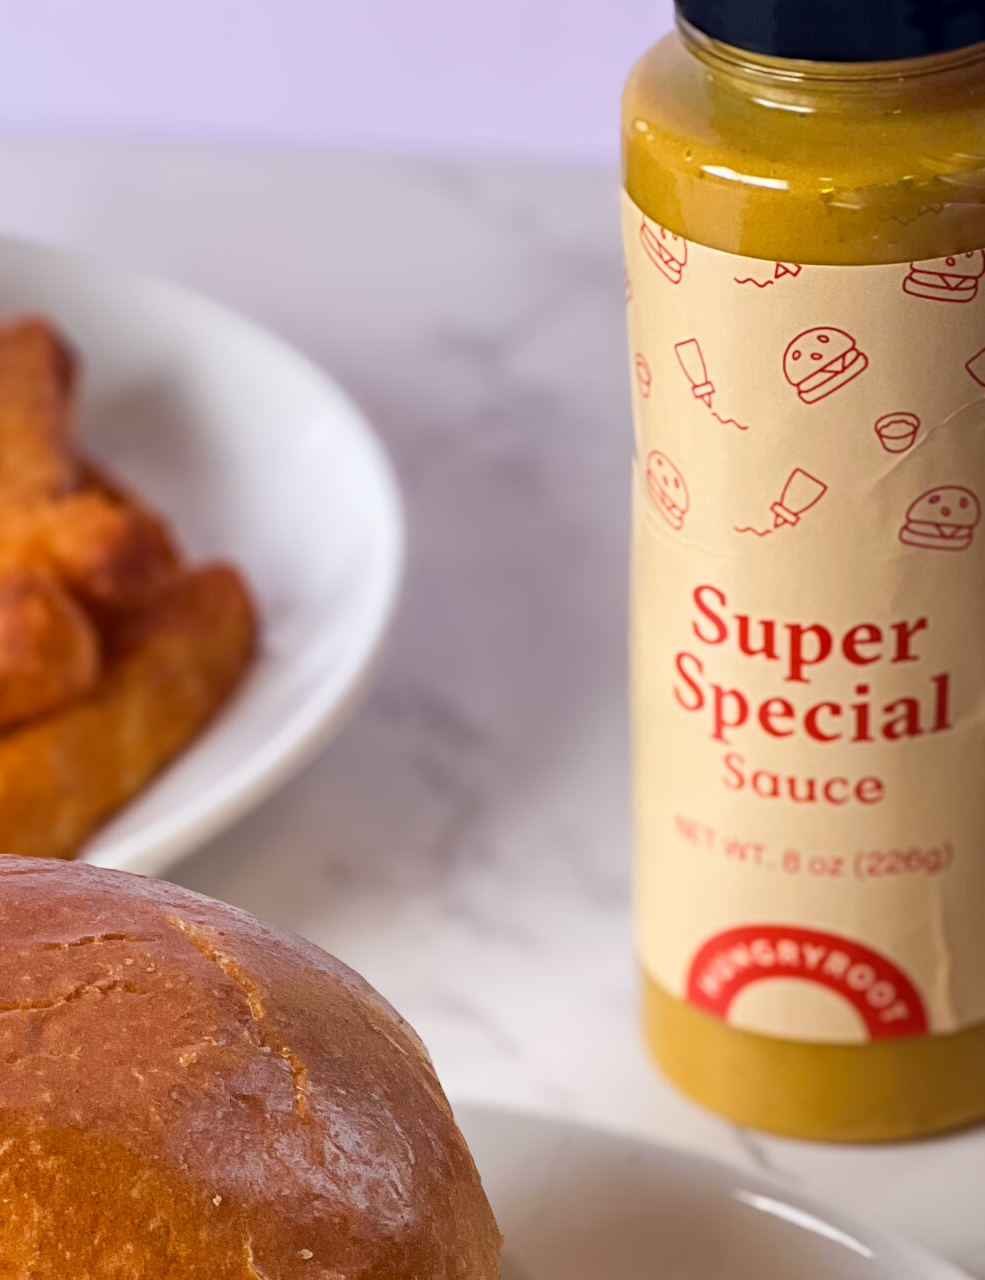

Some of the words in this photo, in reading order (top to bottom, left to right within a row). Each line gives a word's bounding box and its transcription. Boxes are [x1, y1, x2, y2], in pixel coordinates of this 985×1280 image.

[692, 584, 928, 683] Super
[673, 652, 952, 744] Special
[723, 753, 885, 806] Sauce
[675, 815, 716, 852] NET
[782, 851, 801, 876] 8
[808, 857, 845, 877] oz
[855, 839, 954, 880] (226g)
[698, 937, 911, 1025] HUNGRYROOT
